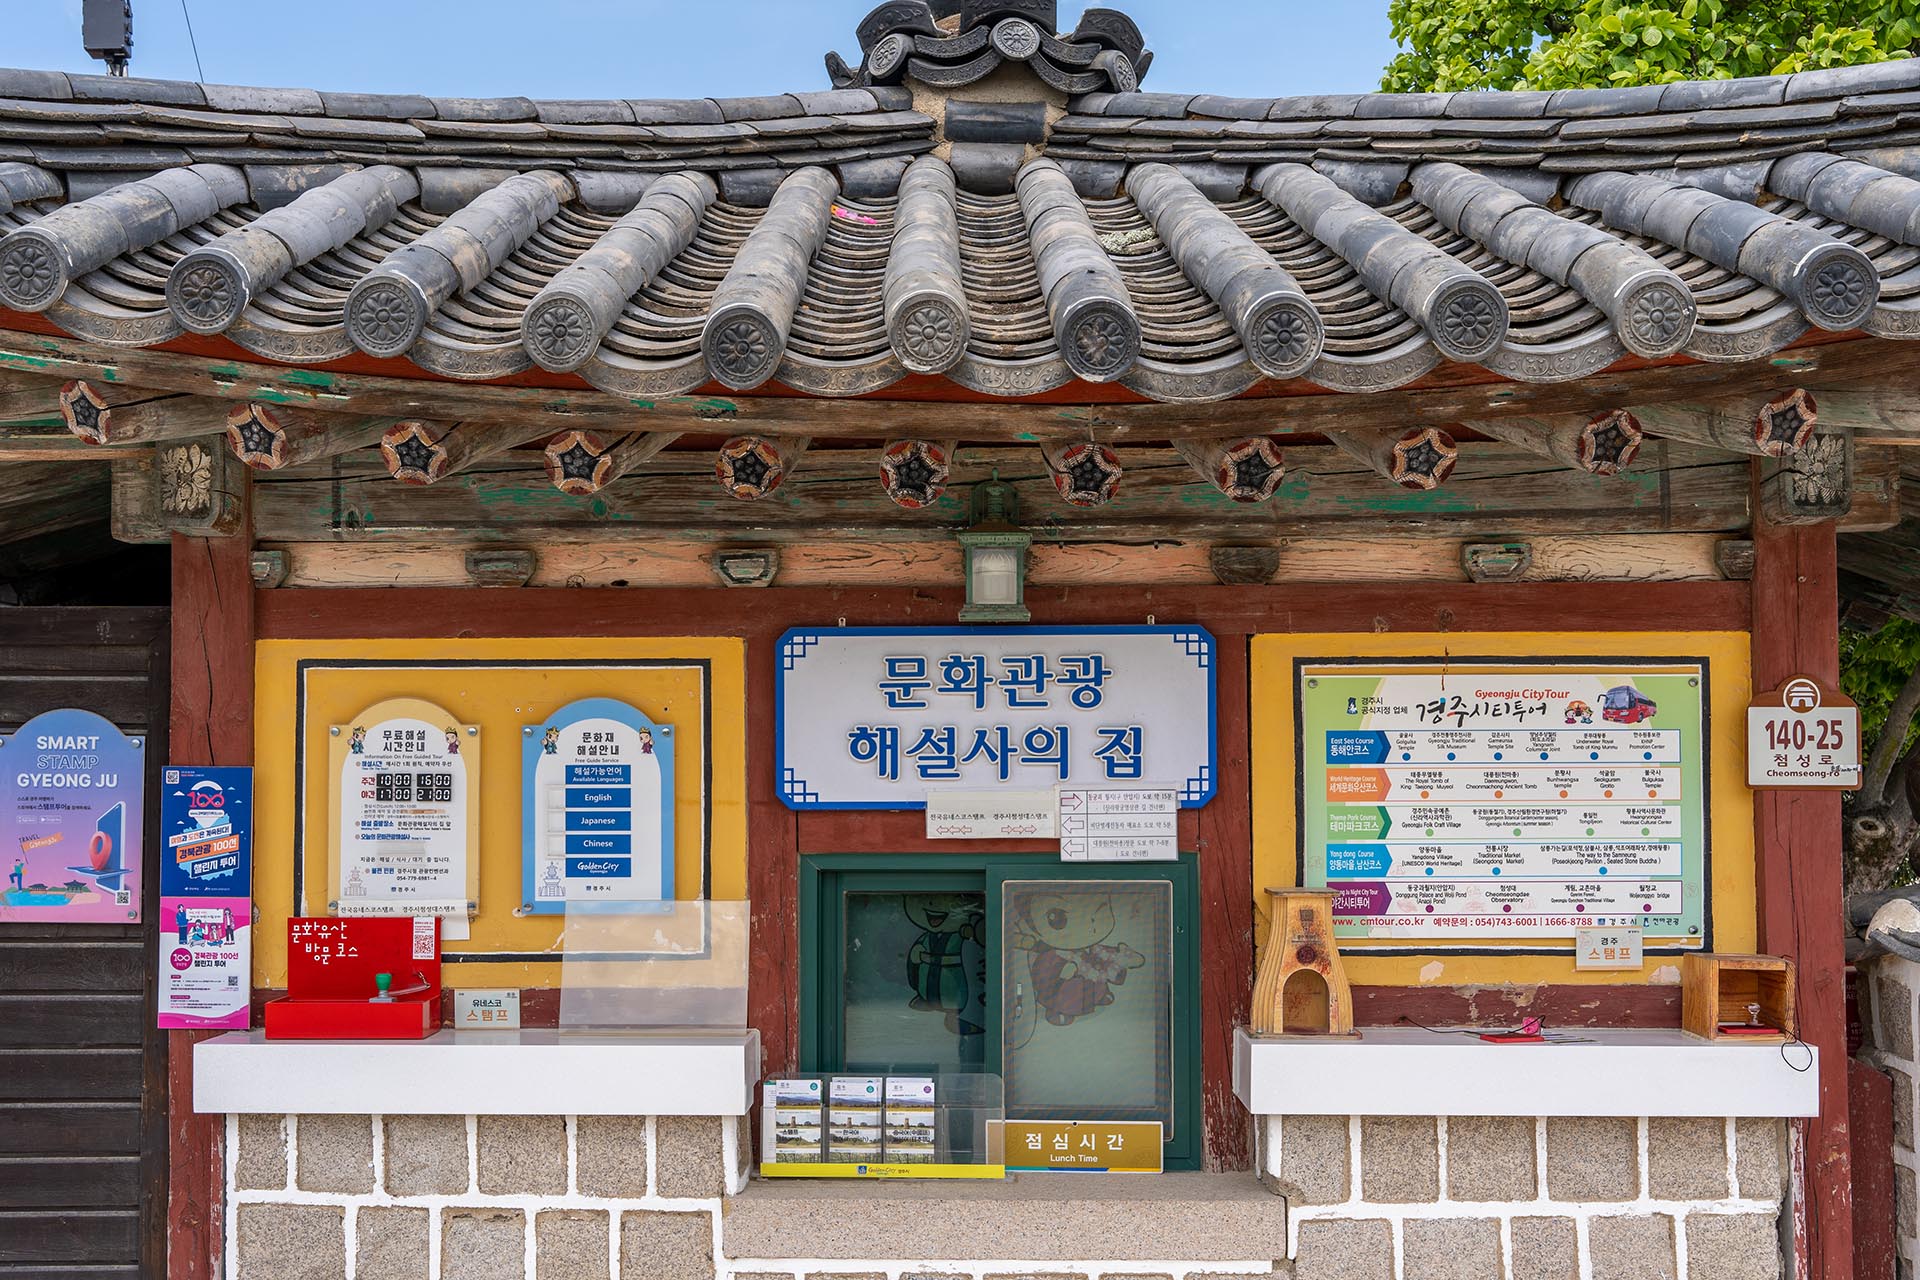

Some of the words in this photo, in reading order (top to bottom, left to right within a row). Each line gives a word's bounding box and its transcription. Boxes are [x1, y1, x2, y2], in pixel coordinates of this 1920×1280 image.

[878, 653, 1113, 711] 문화관광
[1475, 689, 1520, 700] Gyeongju
[1361, 697, 1383, 705] 경주시
[1361, 706, 1391, 714] 공식지정
[1393, 706, 1408, 714] 업체
[1415, 695, 1547, 728] 경주시티투어
[382, 730, 426, 741] 무료해설
[582, 732, 614, 743] 문화재
[1764, 719, 1844, 750] 140-25
[37, 736, 99, 750] SMART
[383, 741, 425, 752] 시간안내
[577, 745, 619, 756] 해설안내
[846, 723, 1072, 782] 해설사의
[1093, 723, 1146, 782] 집
[1330, 745, 1370, 756] 동해안코스
[37, 754, 98, 770] STAMP
[1774, 753, 1834, 768] 첨성로
[574, 767, 622, 776] 해설가능언어
[1766, 769, 1840, 778] Cheomseong-ro
[17, 773, 91, 788] GYEONG
[95, 773, 118, 788] JU
[361, 777, 375, 785] 주간
[1330, 782, 1378, 793] 세계문화유산코스
[361, 790, 375, 799] 야간
[584, 793, 612, 802] English
[581, 817, 616, 826] Japanese
[1330, 821, 1380, 832] 테마파크코스
[180, 843, 212, 860] 경북관광
[213, 837, 237, 852] 100선
[1343, 850, 1356, 858] dong
[220, 855, 237, 869] 투어
[1360, 917, 1425, 926] cmtour.co.kr
[1433, 917, 1468, 927] 예약문의
[1475, 917, 1538, 928] 054)743-6001
[1544, 917, 1593, 926] 1666-8788
[1609, 918, 1637, 926] 경주시
[291, 921, 347, 943] 문화유산
[1601, 937, 1618, 945] 경주
[194, 951, 218, 960] 경북관광
[220, 951, 239, 960] 100선
[305, 943, 331, 965] 방문
[336, 943, 358, 957] 코스
[1588, 947, 1631, 960] 스탬프
[472, 999, 502, 1007] 유네스코
[466, 1009, 508, 1021] 스탬프
[1025, 1132, 1124, 1151] 점심시간
[1050, 1154, 1076, 1162] Lunch
[1078, 1154, 1098, 1162] Time
